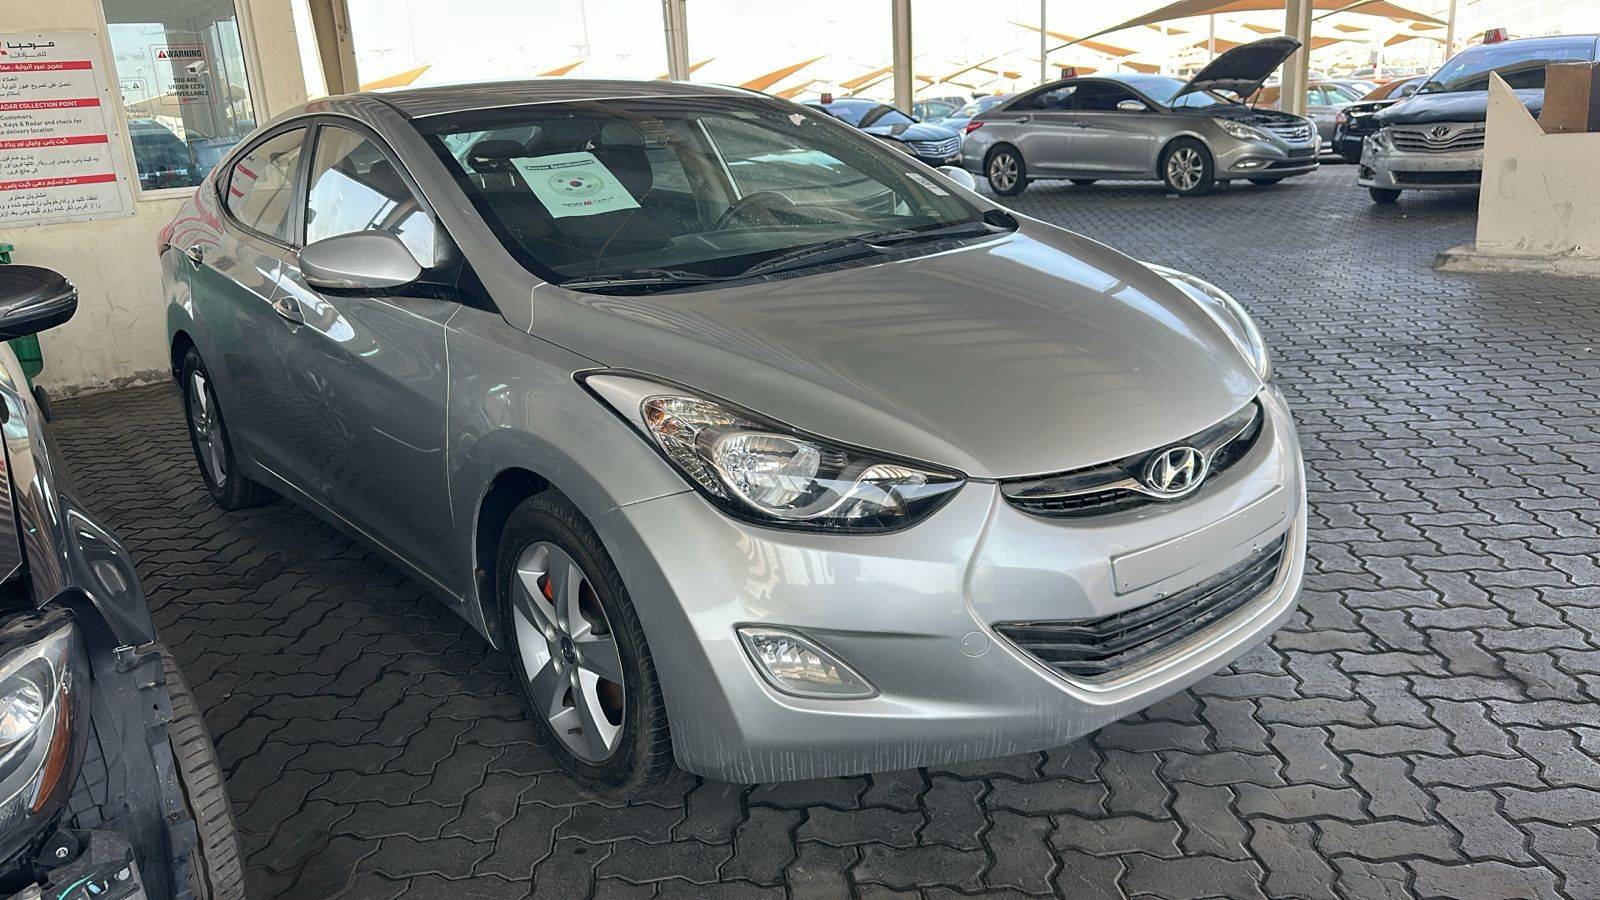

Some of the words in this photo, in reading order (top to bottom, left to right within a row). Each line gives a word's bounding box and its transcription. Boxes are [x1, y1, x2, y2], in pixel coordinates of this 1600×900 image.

[7, 41, 54, 50] مرحبا
[166, 49, 202, 58] WARNING
[18, 102, 58, 110] COLLECTION
[6, 128, 29, 136] delivery
